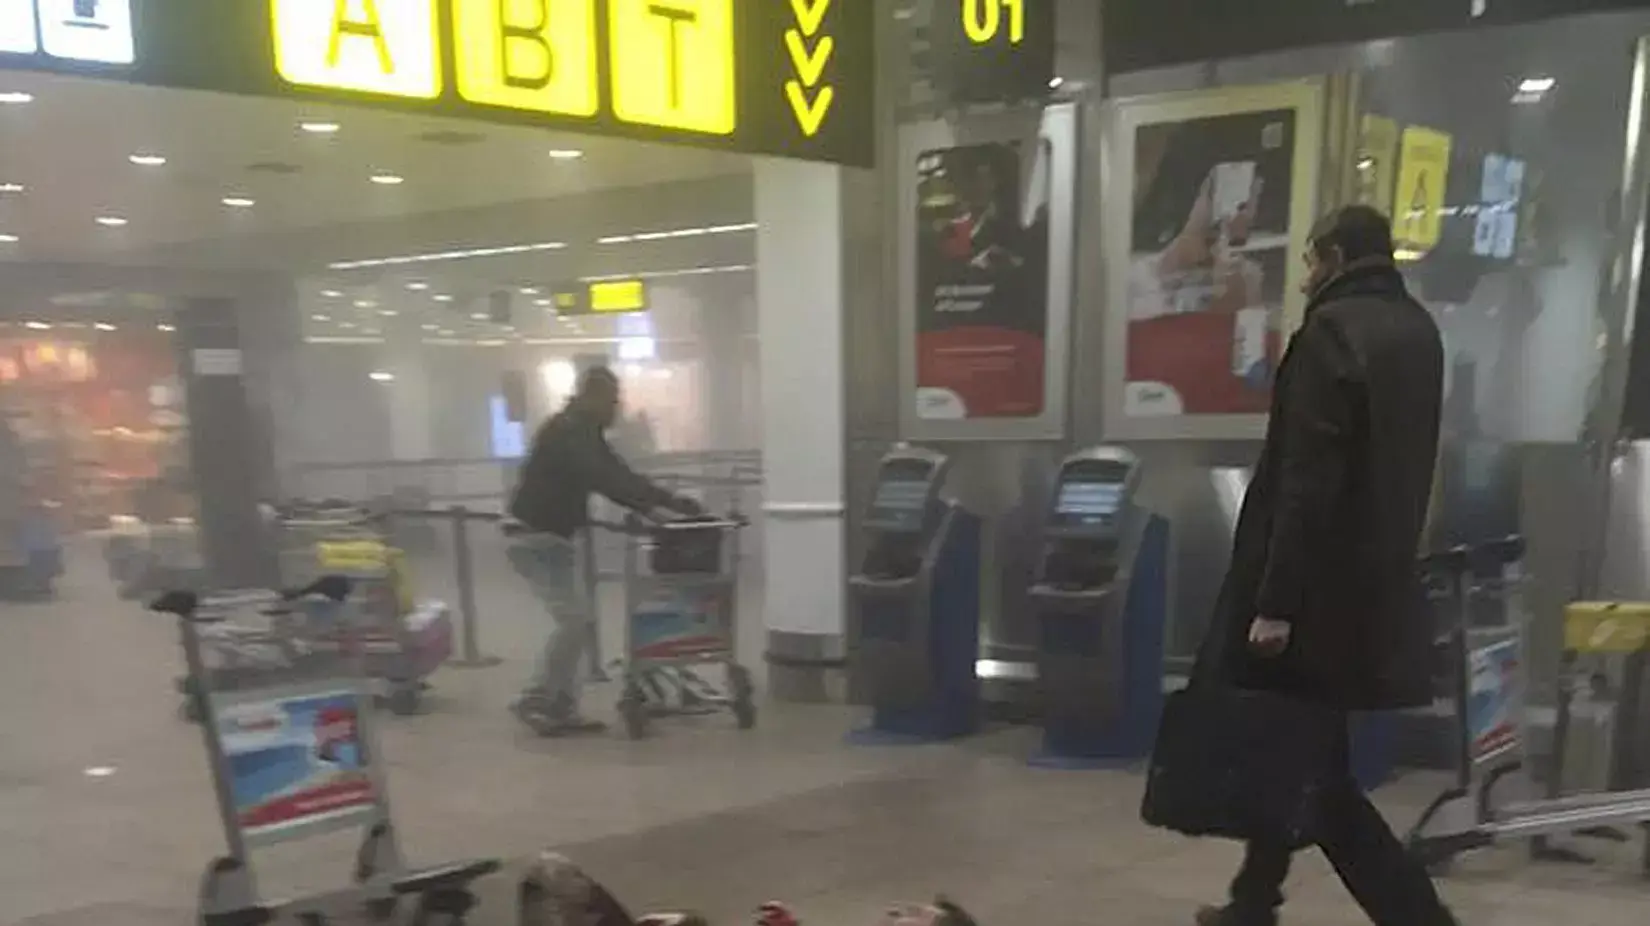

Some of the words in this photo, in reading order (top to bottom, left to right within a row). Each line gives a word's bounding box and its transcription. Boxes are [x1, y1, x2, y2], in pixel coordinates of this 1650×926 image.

[326, 0, 394, 74] A
[499, 0, 553, 90] B
[649, 4, 696, 109] T
[963, 0, 1024, 43] 01
